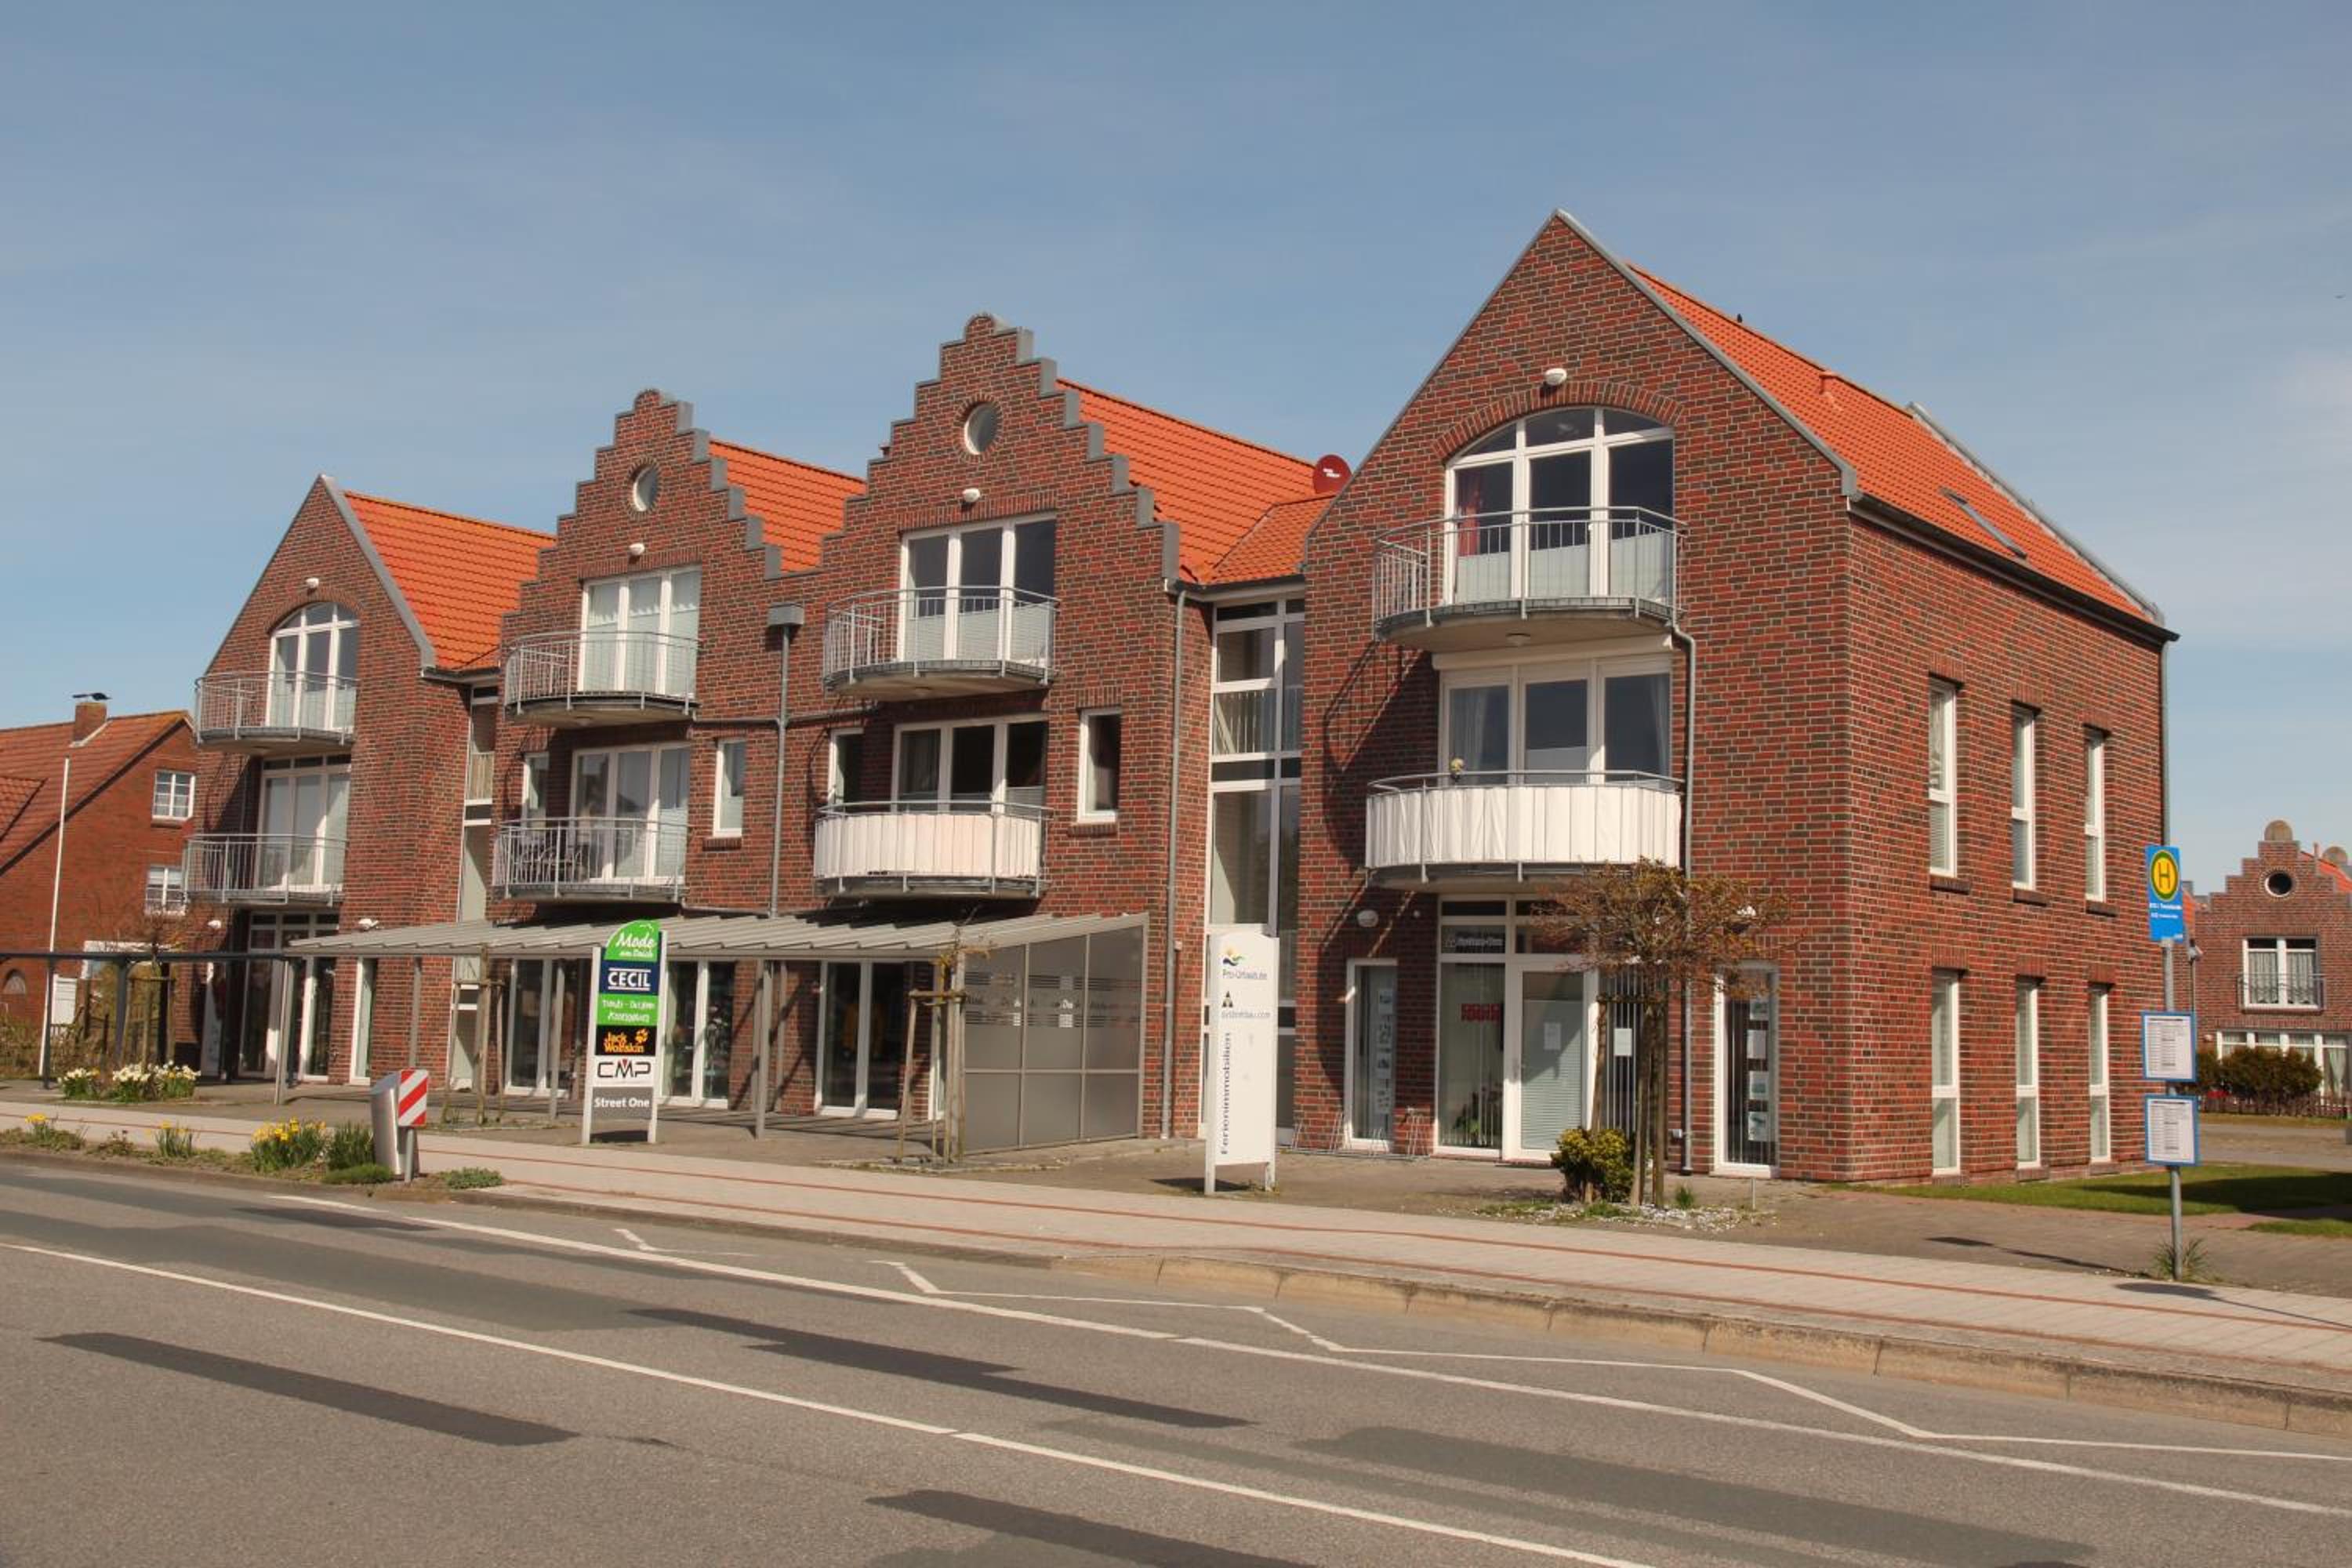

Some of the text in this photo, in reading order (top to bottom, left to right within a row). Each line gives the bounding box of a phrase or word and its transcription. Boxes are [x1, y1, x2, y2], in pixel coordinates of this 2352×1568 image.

[2158, 862, 2171, 890] H
[615, 931, 655, 948] Mode
[608, 972, 652, 987] CECIL
[603, 1032, 627, 1047] Jack
[604, 1043, 644, 1053] Wolfskin
[597, 1059, 651, 1078] CMP
[593, 1098, 650, 1108] Street One
